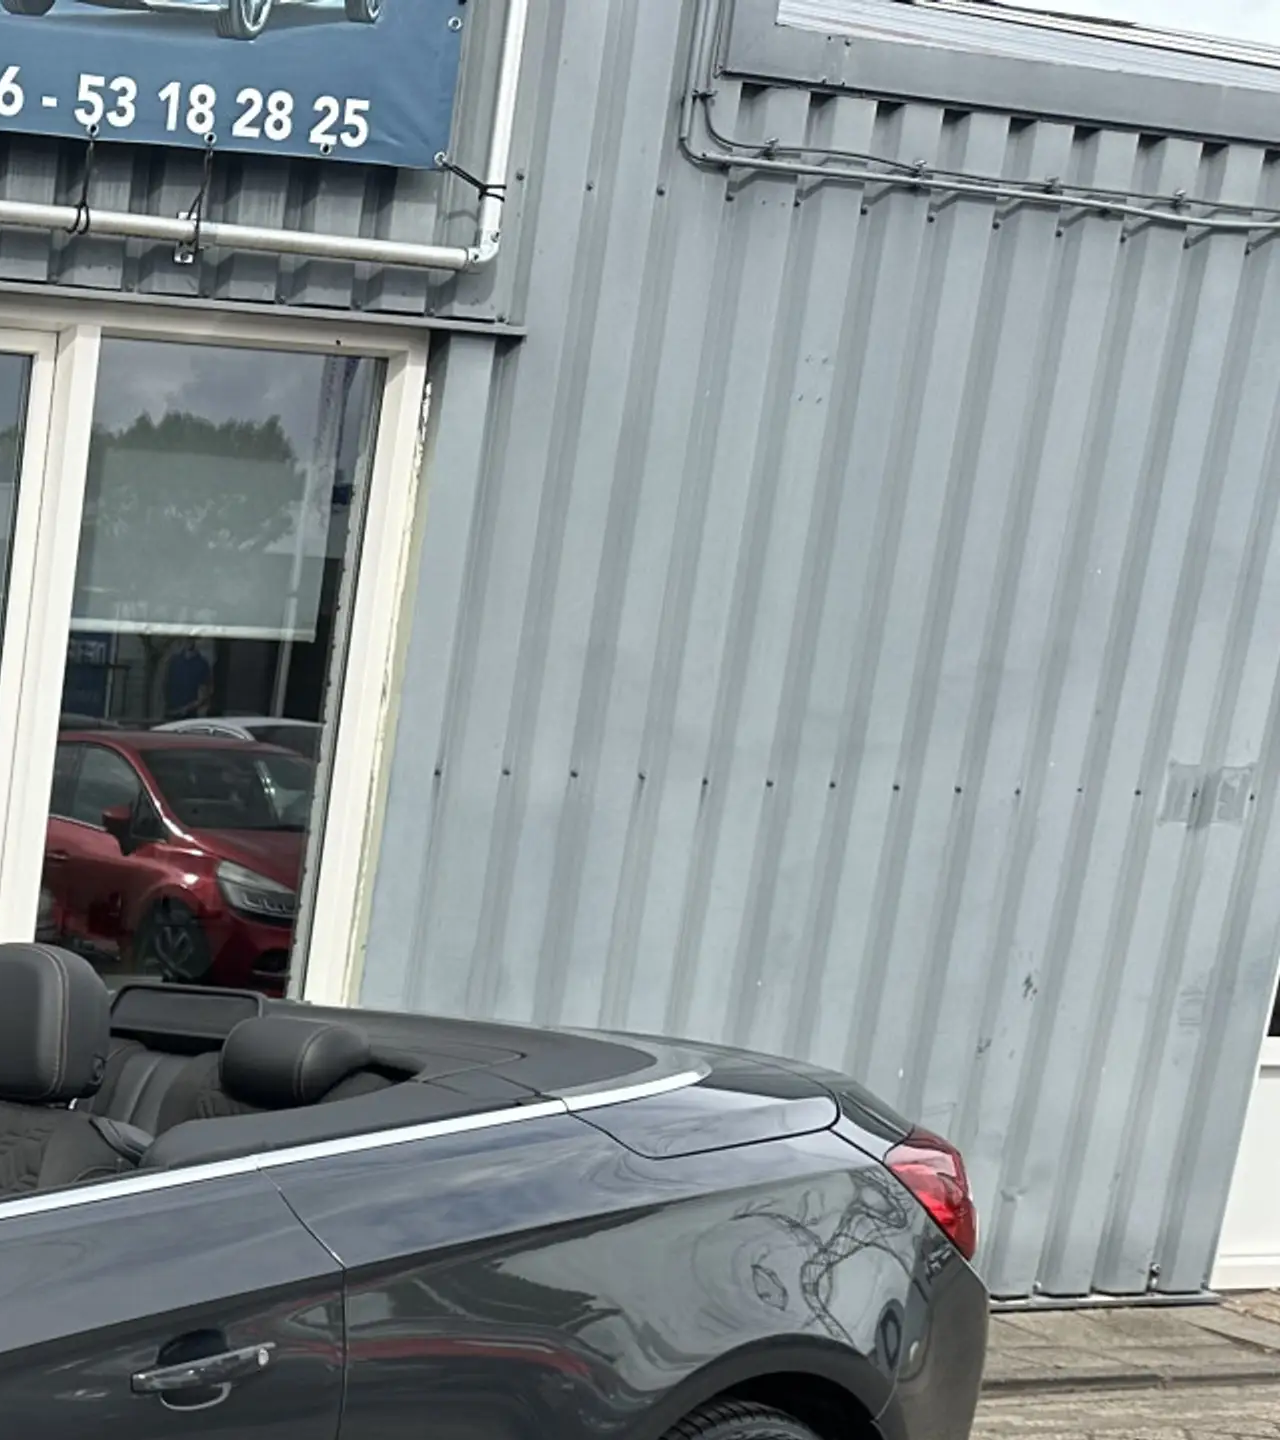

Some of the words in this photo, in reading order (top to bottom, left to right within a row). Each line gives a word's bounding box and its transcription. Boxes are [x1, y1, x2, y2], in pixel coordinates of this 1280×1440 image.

[74, 73, 138, 128] 53
[157, 81, 217, 135] 18
[231, 87, 294, 141] 28
[308, 95, 370, 148] 25
